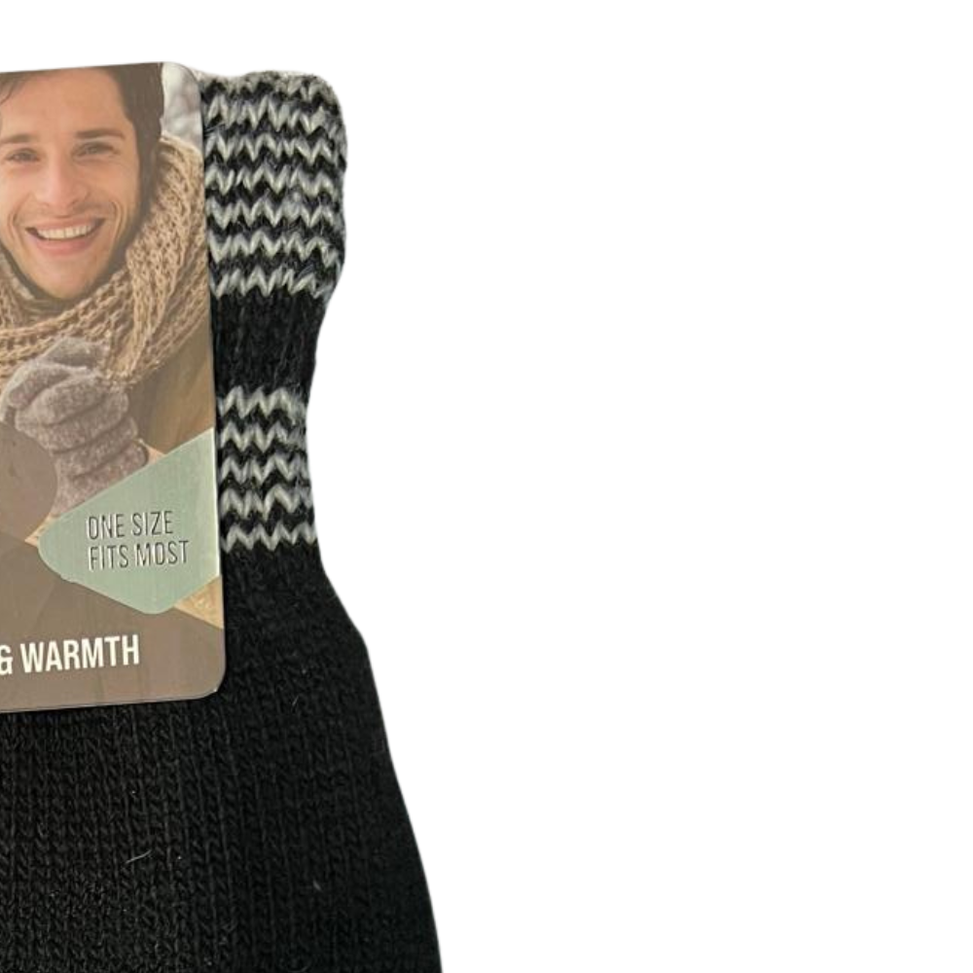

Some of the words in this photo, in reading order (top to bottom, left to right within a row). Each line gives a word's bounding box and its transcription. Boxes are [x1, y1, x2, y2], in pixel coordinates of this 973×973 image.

[86, 513, 126, 541] ONE
[131, 510, 174, 537] SIZE
[87, 544, 130, 573] FITS
[134, 539, 190, 568] MOST
[20, 634, 141, 674] WARMTH
